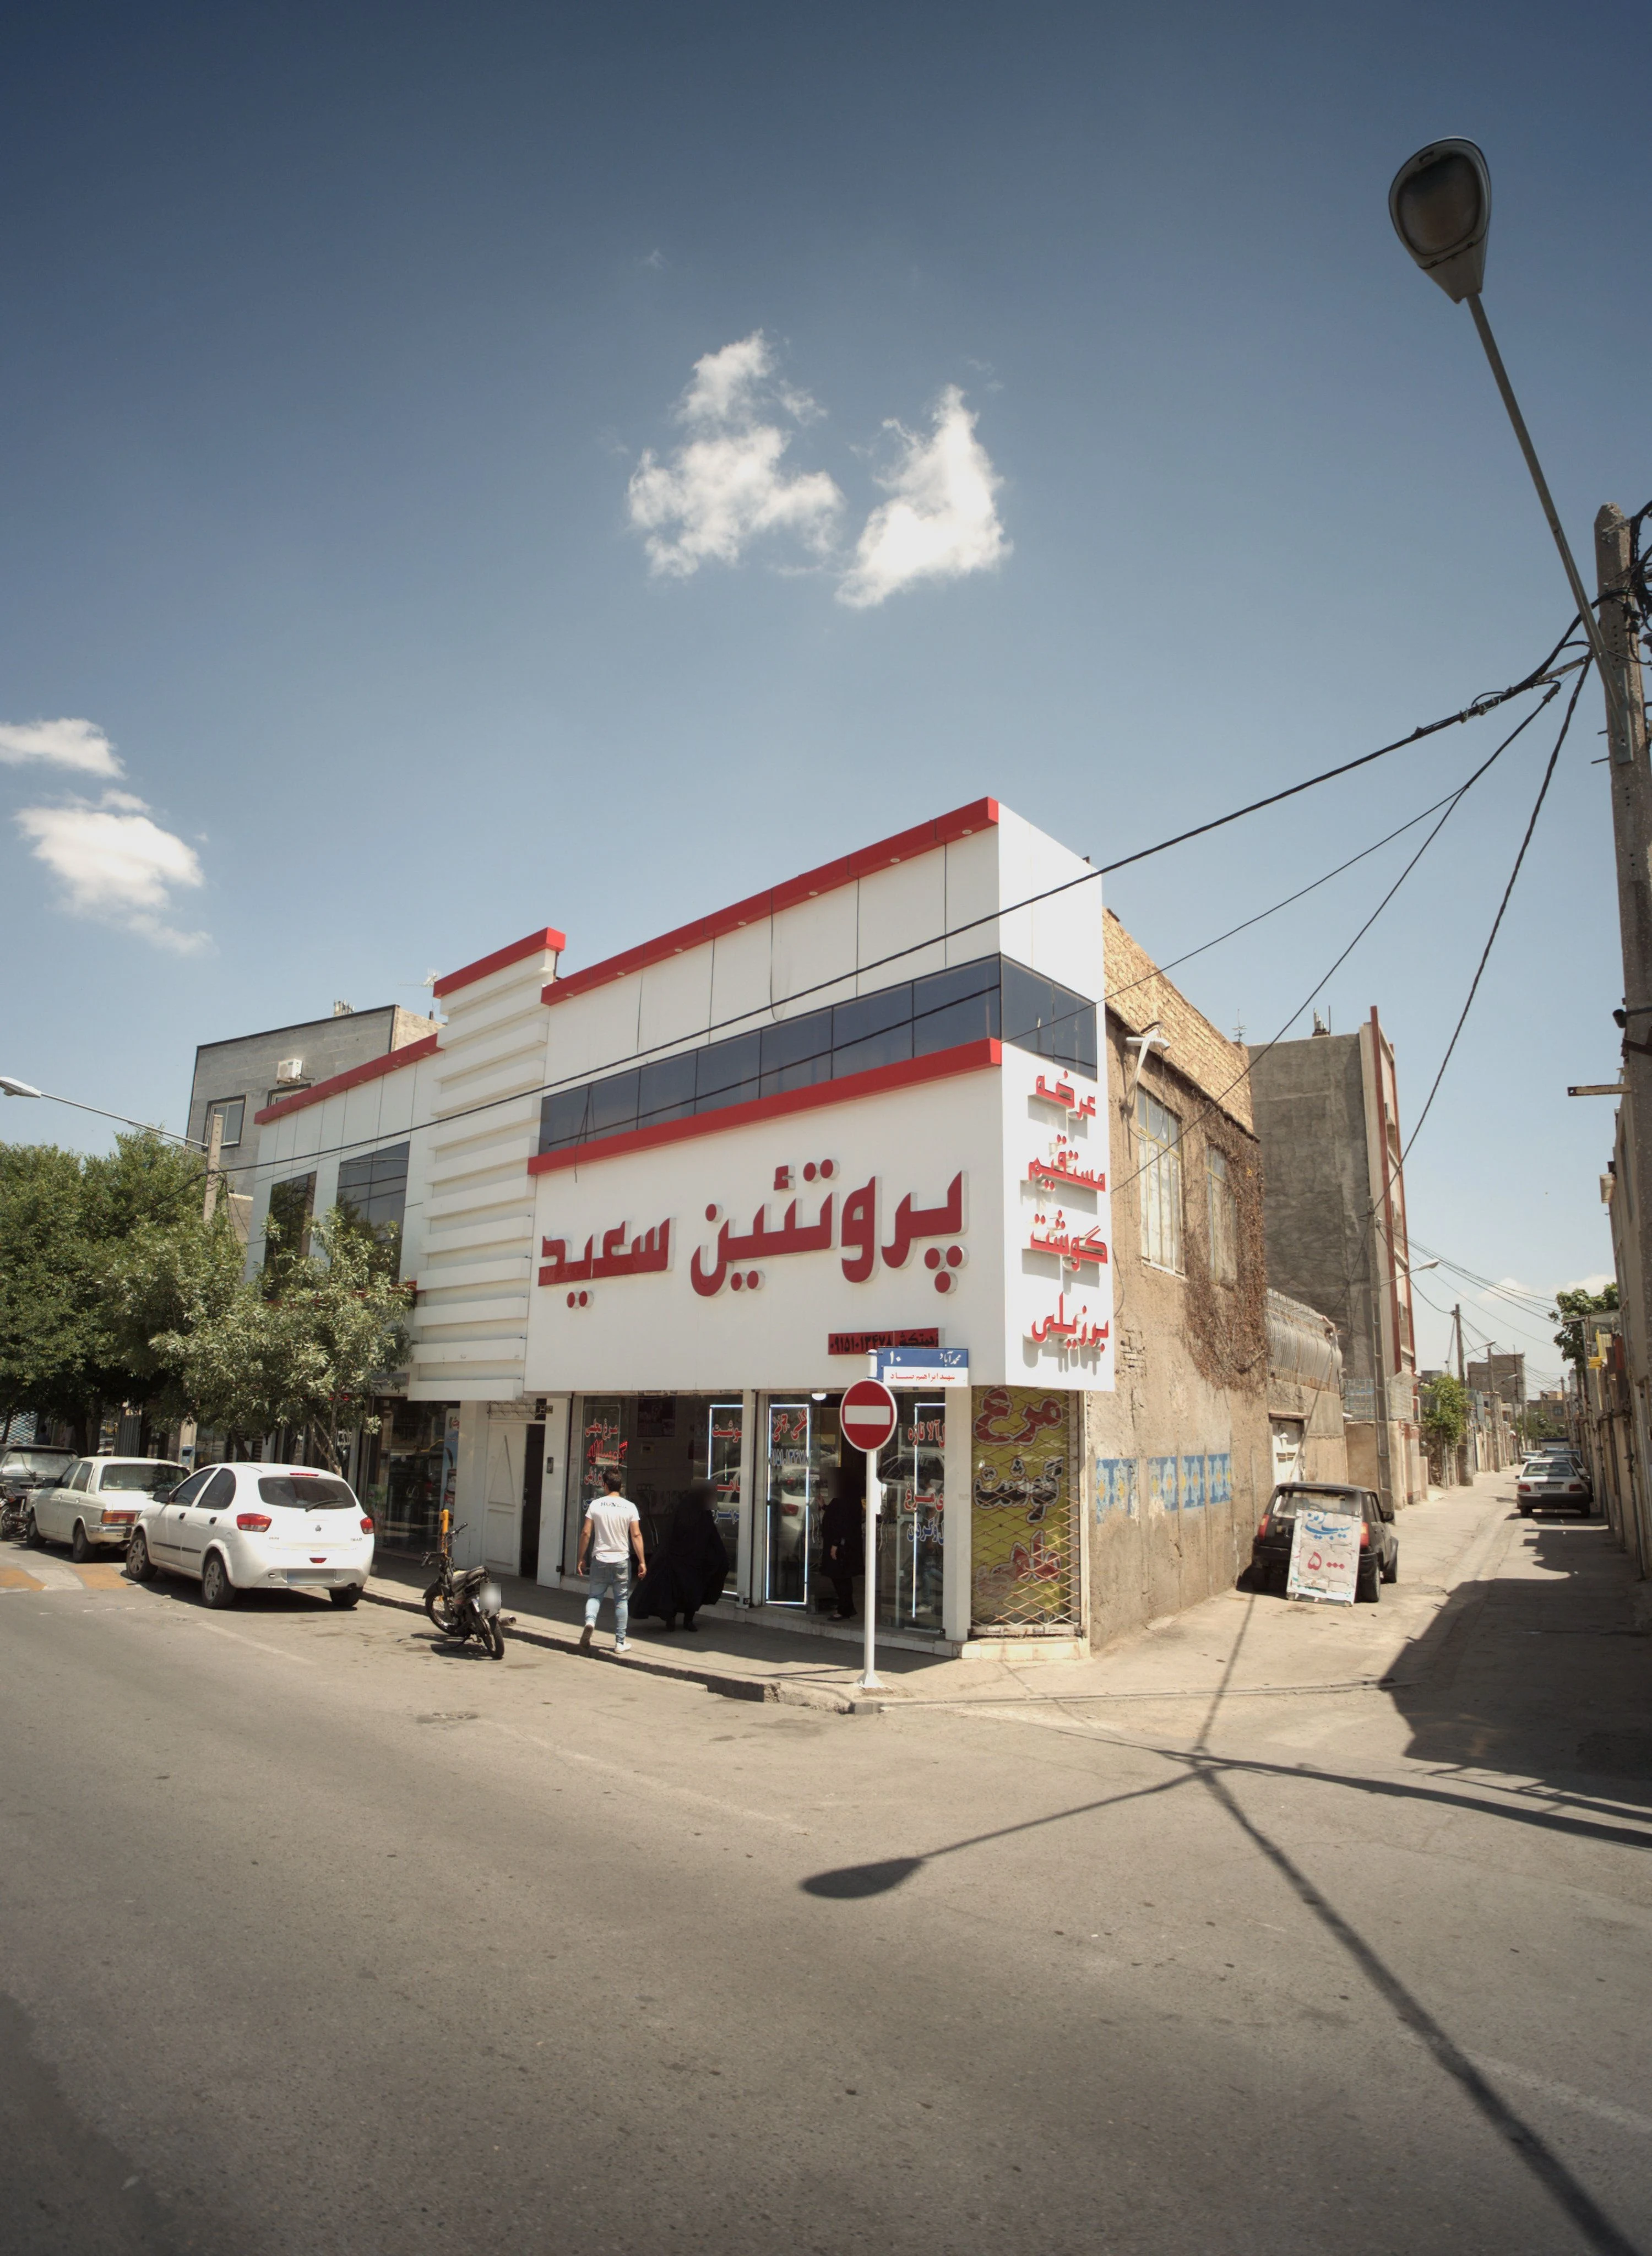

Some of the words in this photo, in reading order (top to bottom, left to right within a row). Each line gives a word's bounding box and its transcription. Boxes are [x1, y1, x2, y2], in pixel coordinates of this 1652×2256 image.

[1035, 1070, 1096, 1119] عرضه
[1028, 1134, 1106, 1192] مستقیم
[690, 1158, 969, 1298] پروتئین
[1030, 1209, 1108, 1271] گوشت
[537, 1217, 677, 1308] سعید
[1031, 1291, 1109, 1353] برزیلی
[889, 1351, 901, 1364] ۱۰
[711, 1419, 742, 1443] وشت
[973, 1455, 1064, 1523] گوشت
